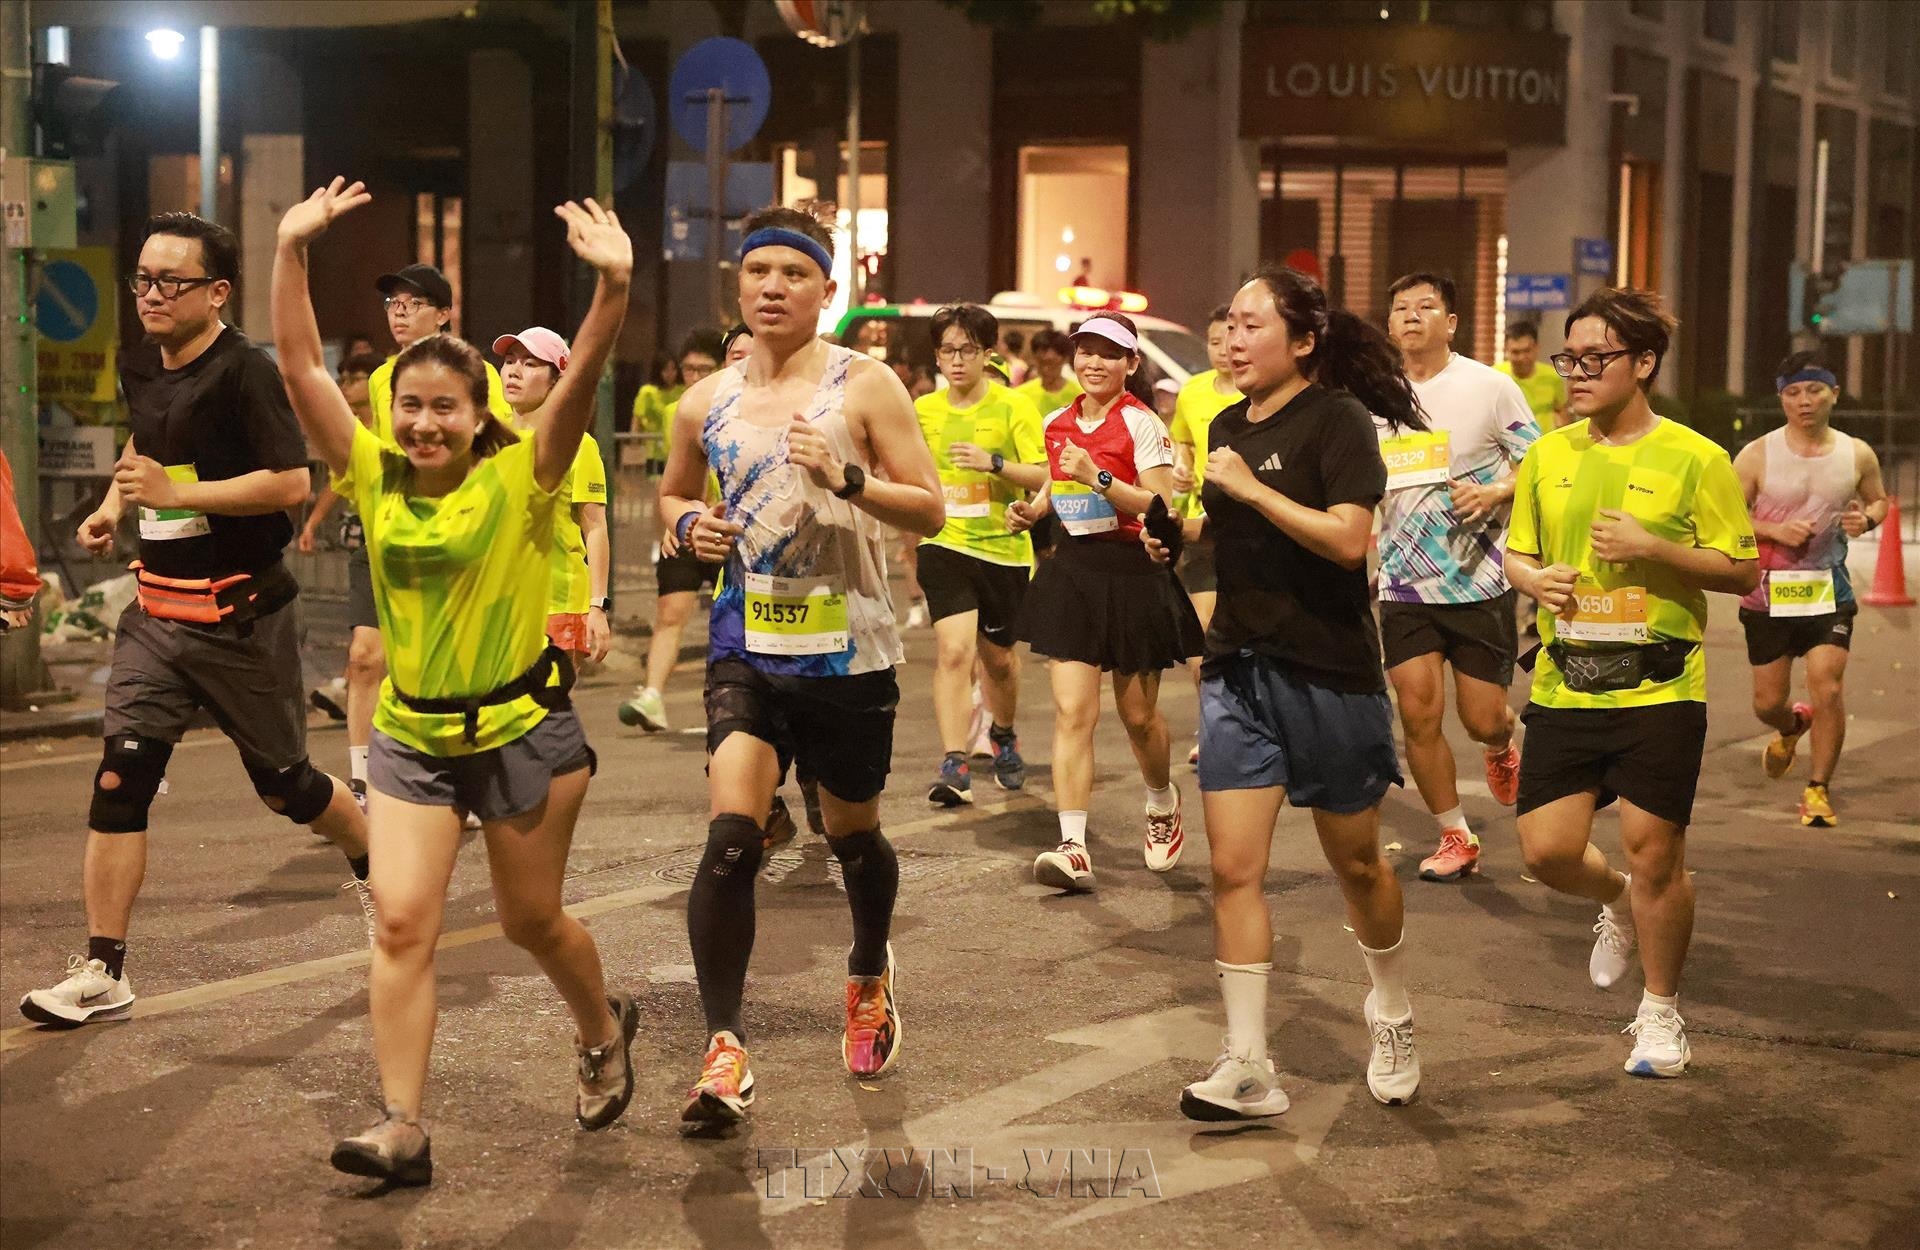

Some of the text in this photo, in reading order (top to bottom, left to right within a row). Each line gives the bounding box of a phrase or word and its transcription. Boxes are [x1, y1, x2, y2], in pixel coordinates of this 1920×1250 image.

[1265, 62, 1564, 103] LOUIS VUITTON
[1386, 449, 1425, 468] 52329
[1056, 499, 1089, 515] 62397
[1775, 585, 1813, 599] 90520
[752, 600, 809, 624] 91537
